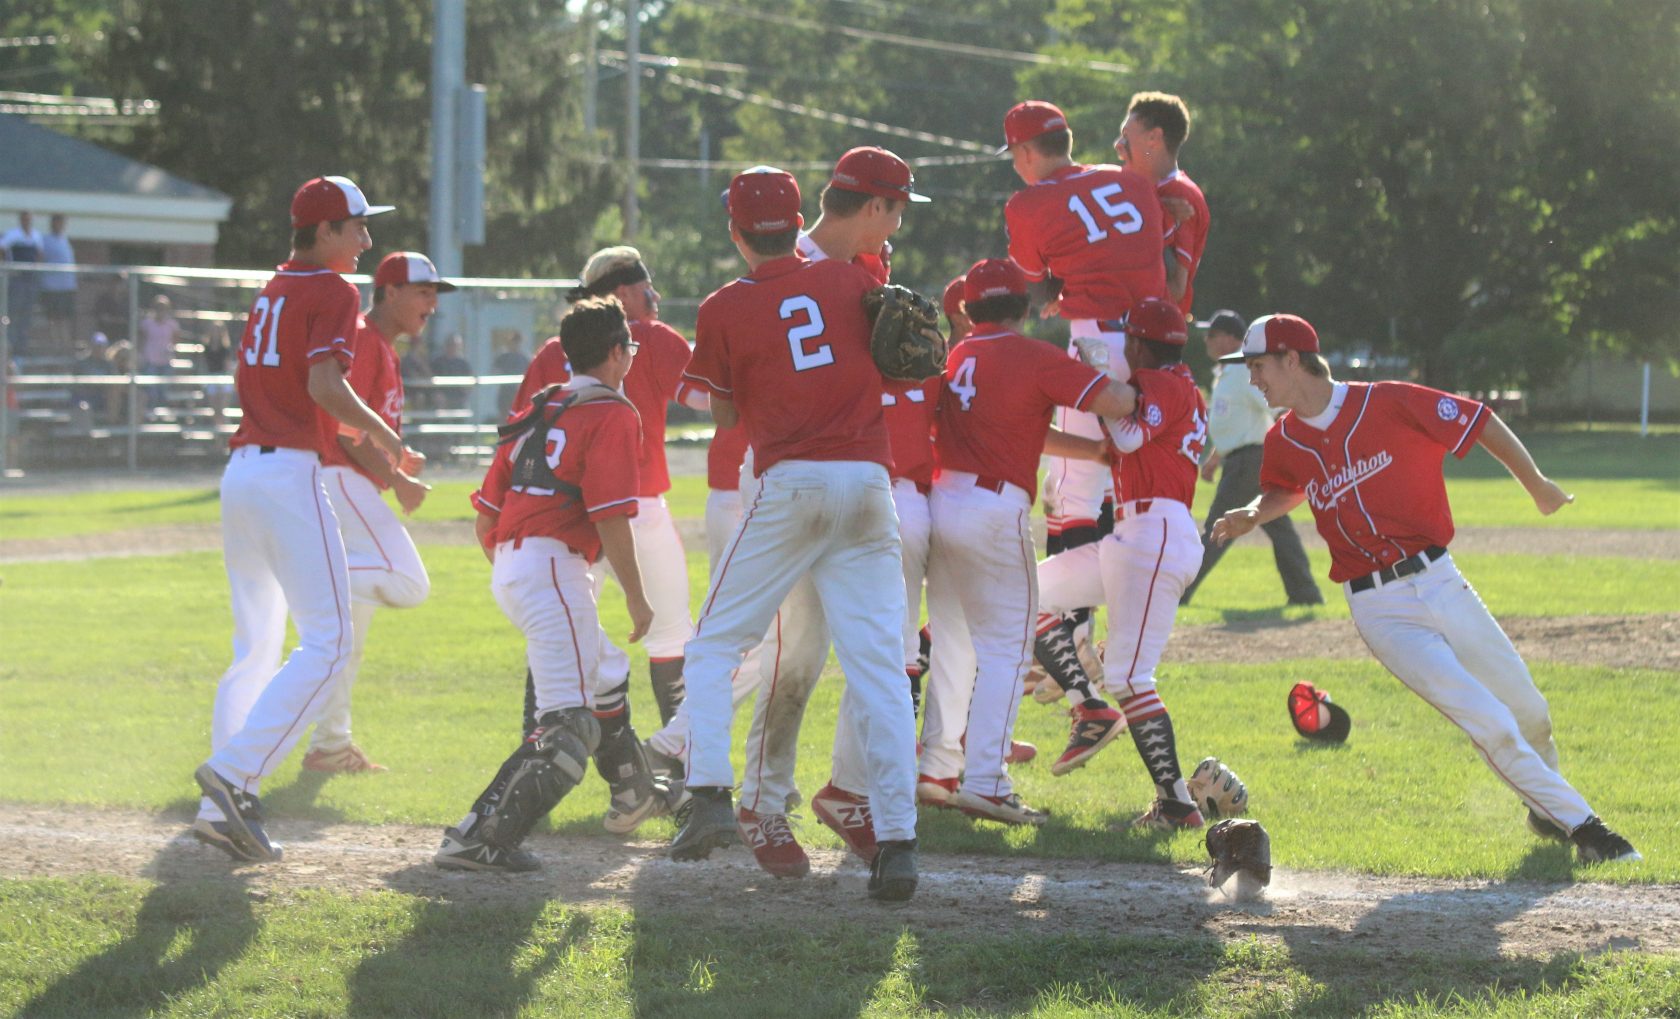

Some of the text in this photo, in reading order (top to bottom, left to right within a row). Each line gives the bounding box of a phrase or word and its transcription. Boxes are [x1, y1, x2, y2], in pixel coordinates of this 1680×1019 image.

[1068, 182, 1144, 244] 15
[245, 295, 287, 367] 31
[778, 294, 835, 372] 2
[948, 356, 977, 412] 4
[1304, 449, 1392, 511] Revolution
